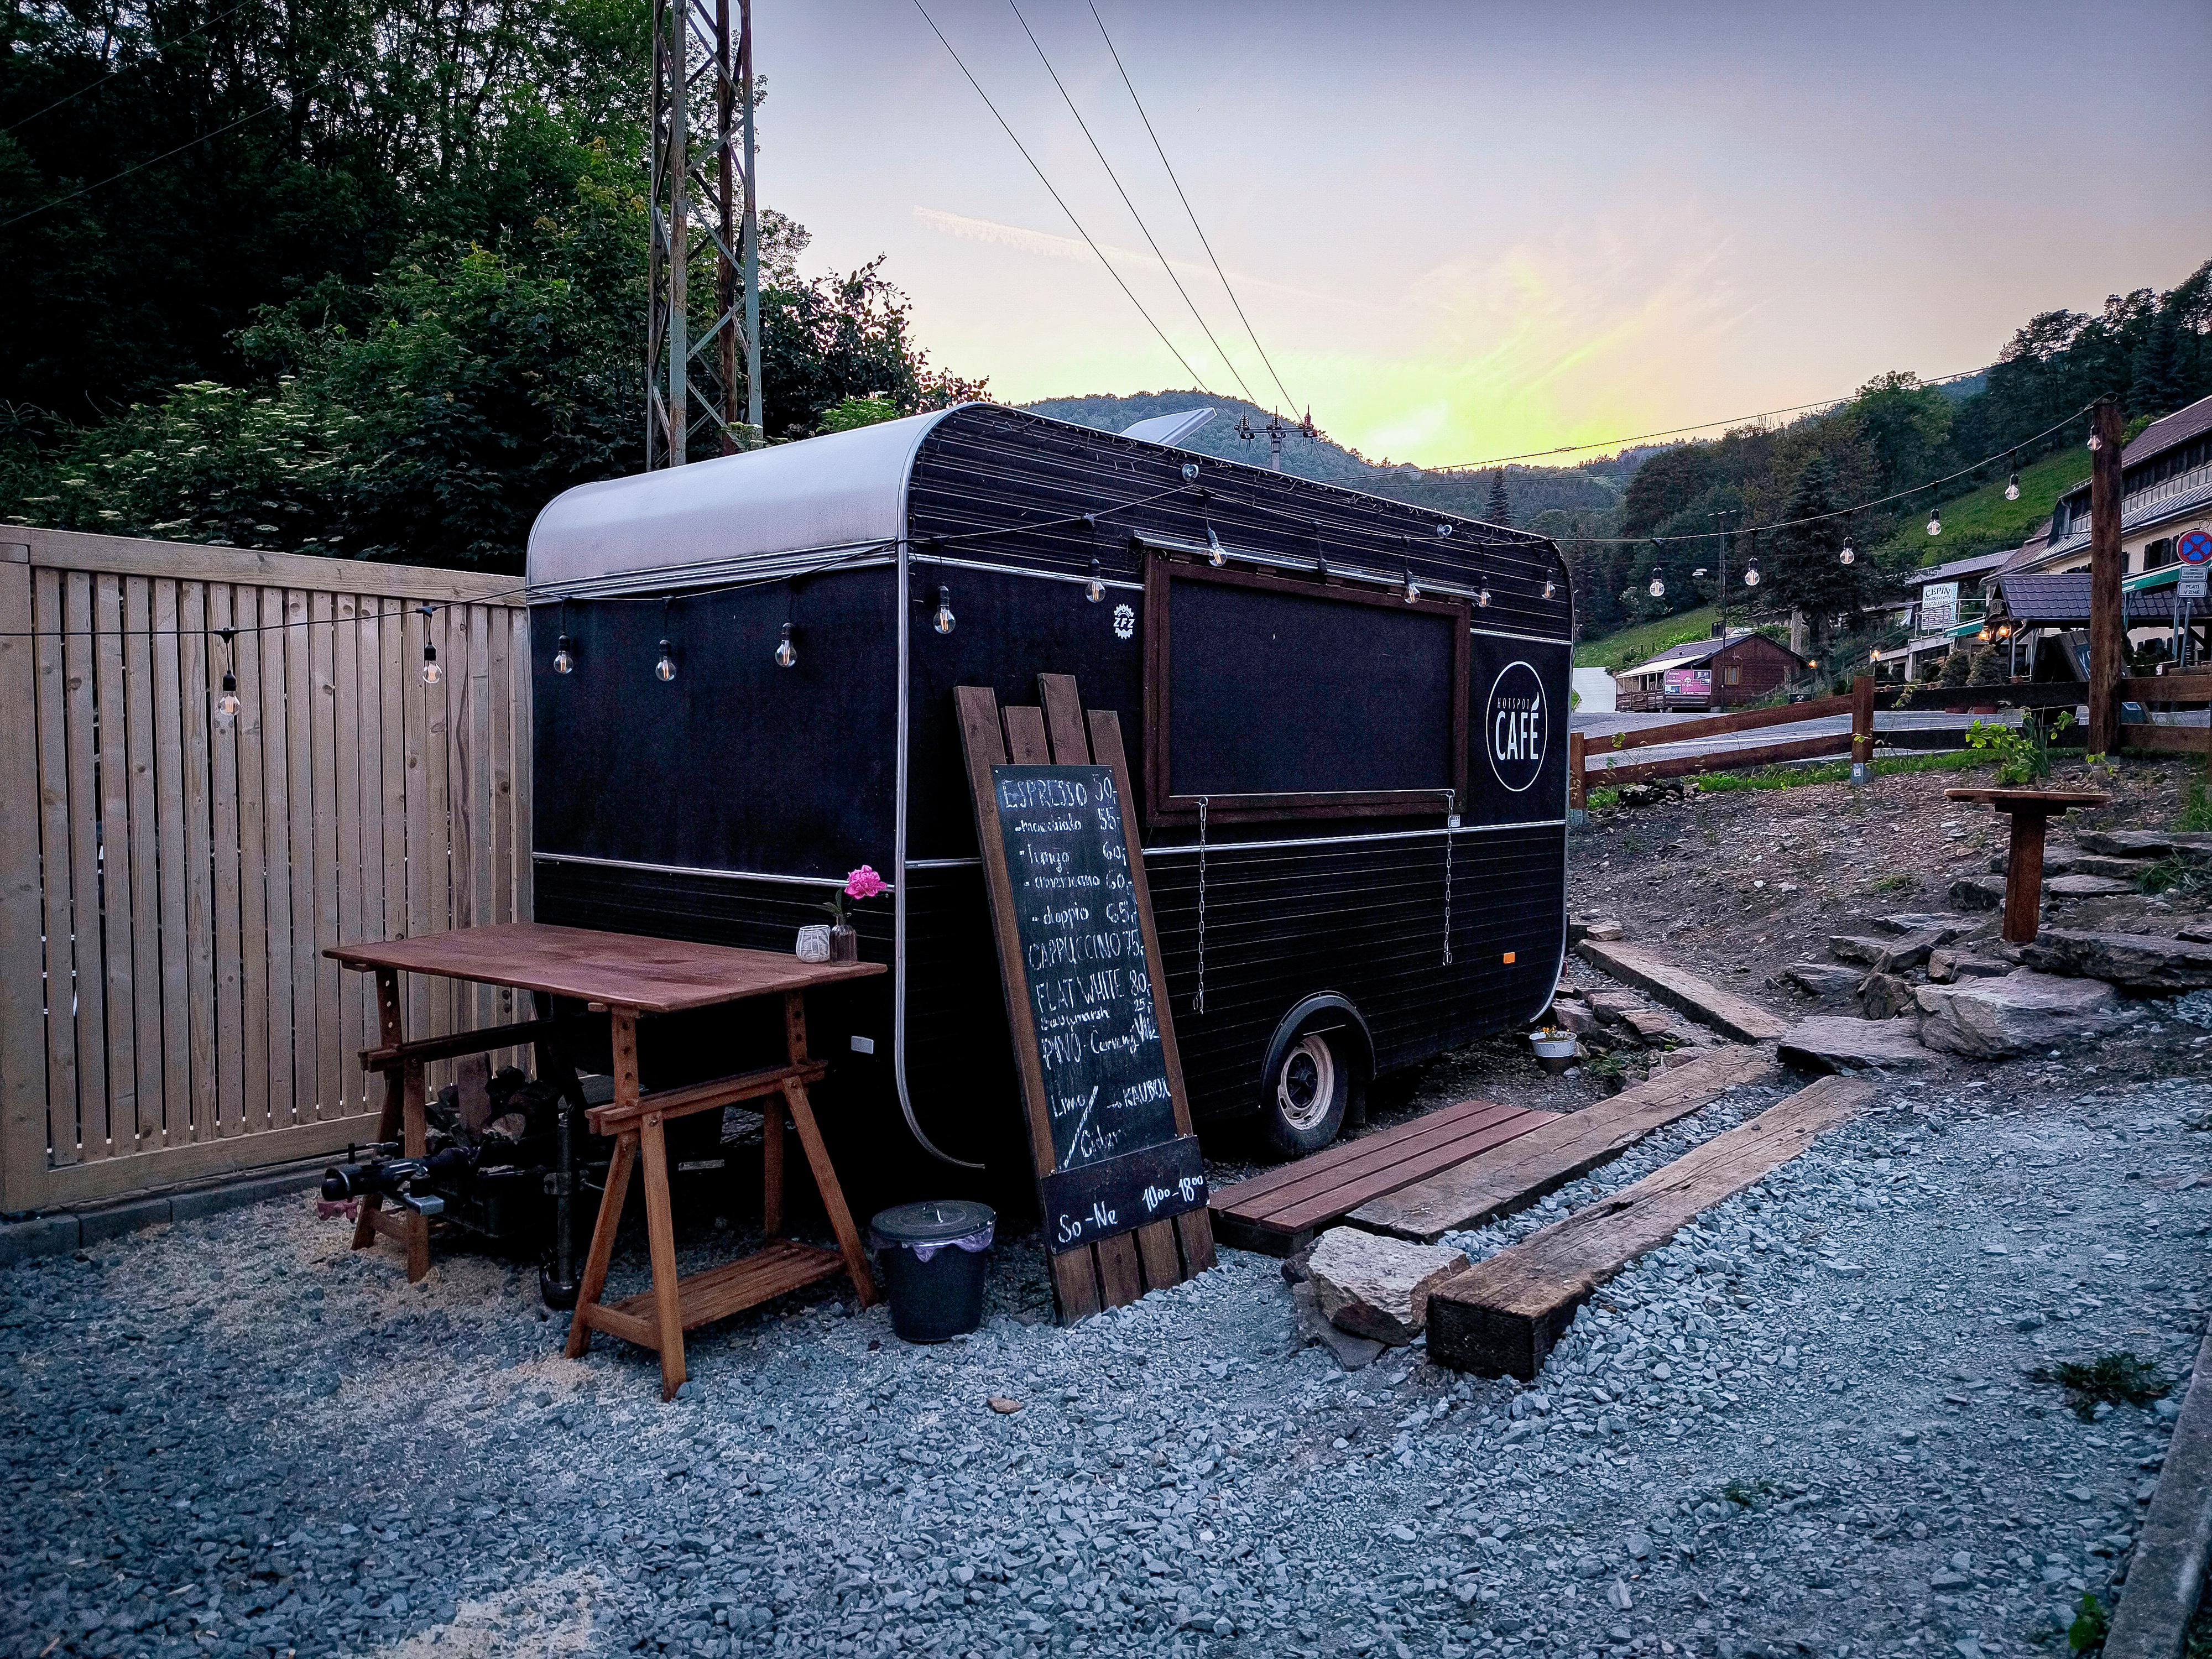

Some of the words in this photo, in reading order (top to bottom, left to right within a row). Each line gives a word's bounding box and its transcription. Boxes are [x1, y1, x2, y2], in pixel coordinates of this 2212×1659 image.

[1113, 617, 1135, 628] ZFZ
[1497, 697, 1530, 709] HOTSPOT
[1001, 779, 1087, 808] ESPRESSO
[1029, 932, 1121, 971] CAPPUCCINO
[1036, 978, 1074, 1013] FLAT
[1077, 968, 1124, 1004] WHITE
